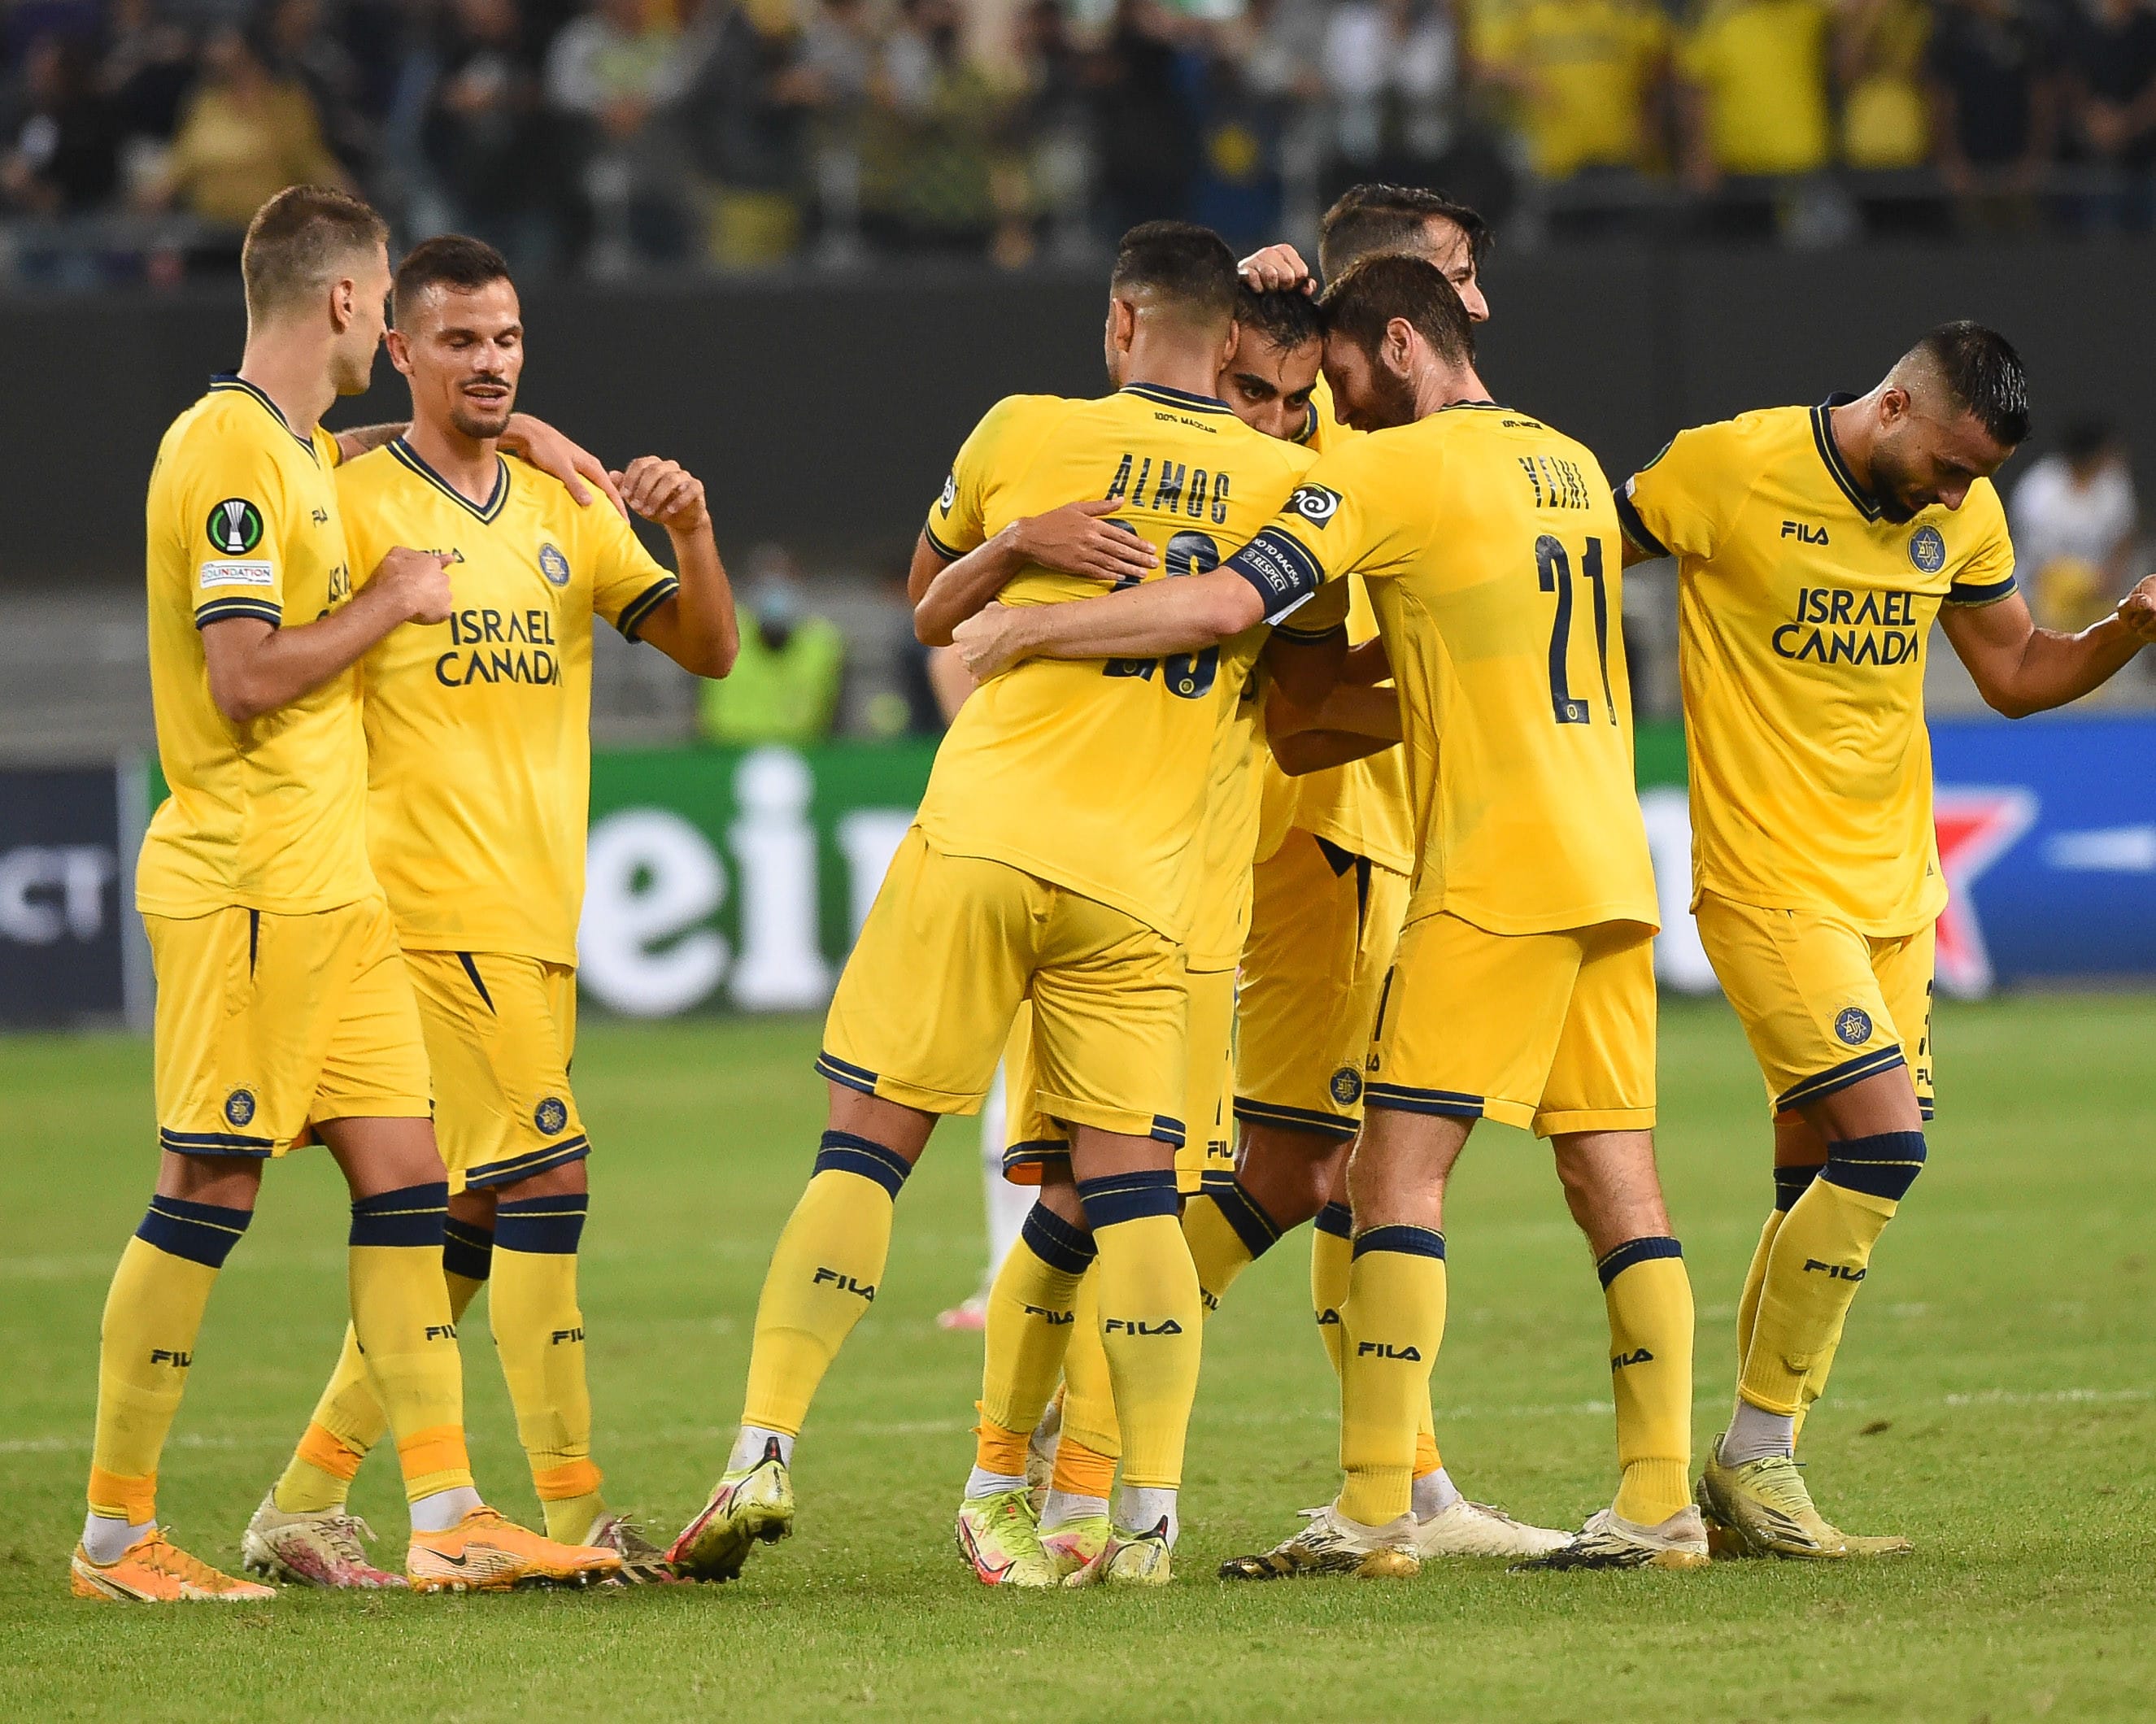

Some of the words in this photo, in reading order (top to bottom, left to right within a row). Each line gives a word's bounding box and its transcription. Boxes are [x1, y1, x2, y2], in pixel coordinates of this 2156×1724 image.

[1154, 411, 1178, 423] 100%
[1105, 453, 1230, 525] ALMOG
[1780, 520, 1829, 546] FILA
[1252, 556, 1287, 592] RESPECT
[1265, 544, 1278, 556] TO
[1274, 552, 1300, 589] RACISM
[1797, 587, 1916, 626] ISRAEL
[451, 610, 555, 646] ISRAEL
[1535, 534, 1617, 726] 21
[1771, 623, 1919, 665] CANADA
[435, 648, 564, 687] CANADA
[1207, 1140, 1234, 1159] FIL
[813, 1267, 874, 1303] FILA
[1105, 1318, 1183, 1336] FILA
[1357, 1341, 1422, 1362] FILA
